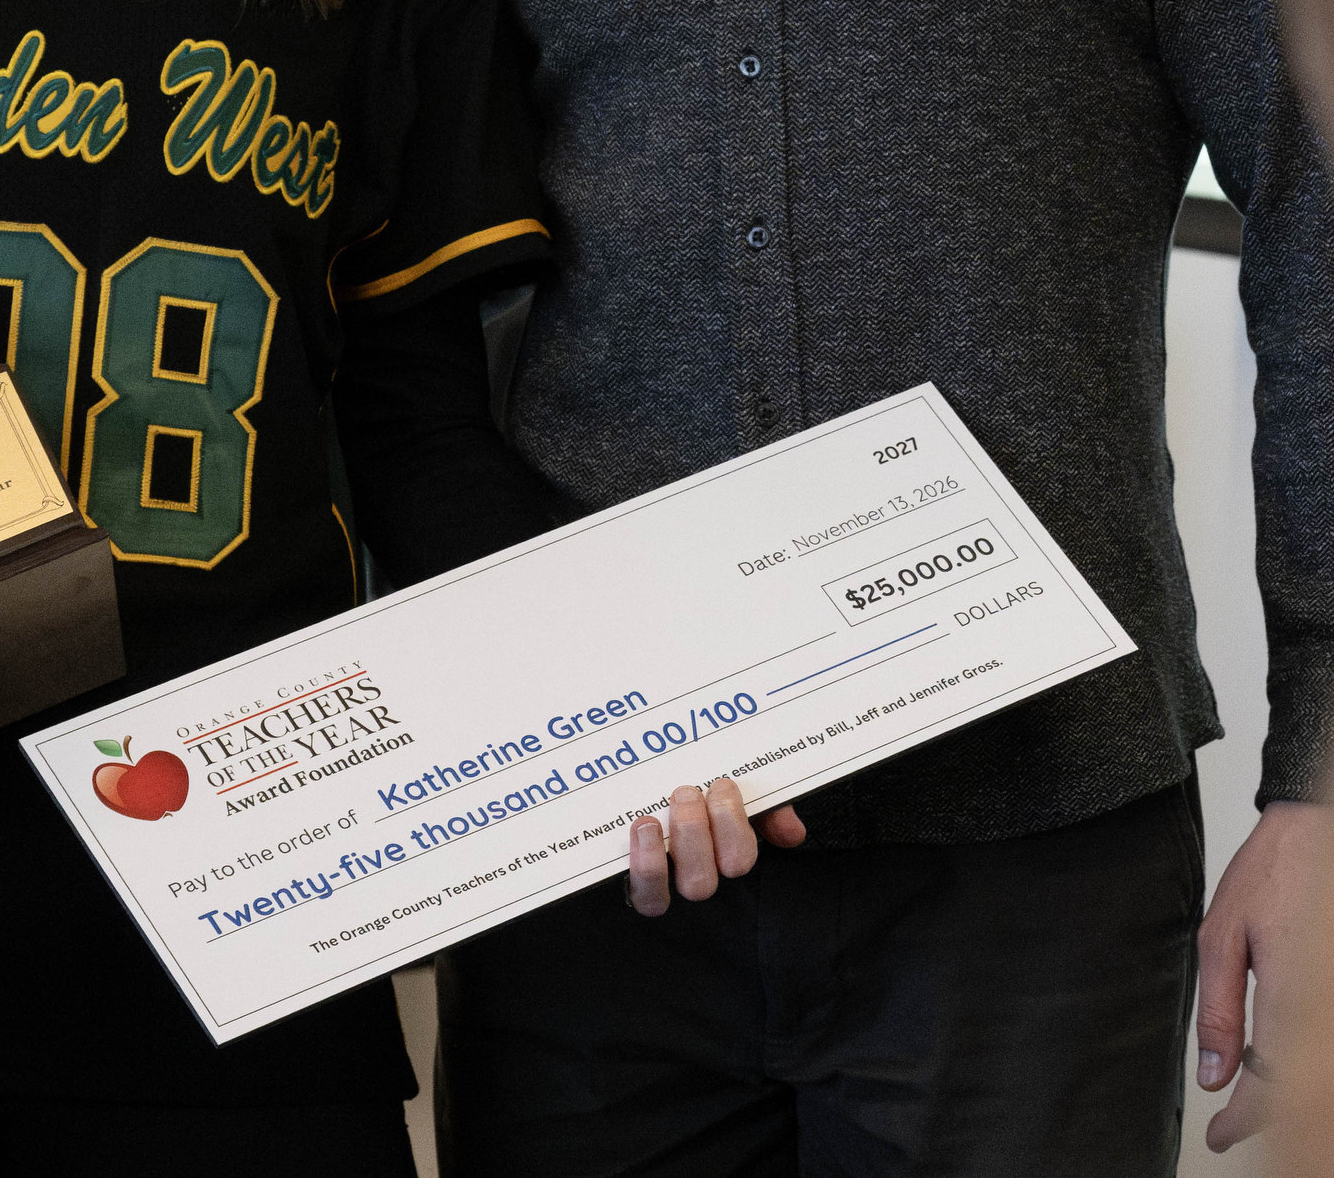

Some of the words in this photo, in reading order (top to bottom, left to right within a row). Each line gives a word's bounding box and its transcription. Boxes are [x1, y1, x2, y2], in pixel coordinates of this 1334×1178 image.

[160, 39, 341, 219] West
[872, 436, 918, 465] 2027
[737, 547, 791, 577] Date:
[791, 507, 886, 552] November
[887, 495, 915, 512] 13,
[913, 475, 959, 503] 2026
[844, 537, 995, 610] $25,000.00
[953, 581, 1044, 627] DOLLARS
[176, 699, 265, 739] ORANGE
[276, 660, 363, 699] COUNTY
[186, 676, 382, 768] TEACHERS
[207, 764, 236, 788] OF
[239, 743, 294, 774] THE
[291, 705, 401, 759] YEAR
[225, 774, 294, 817] Award
[291, 732, 415, 787] Foundation
[167, 874, 209, 900] Pay
[211, 862, 236, 881] to
[237, 846, 275, 871] the
[277, 823, 332, 855] order
[337, 809, 361, 830] of
[376, 733, 543, 811] Katherine
[547, 690, 648, 740] Green
[197, 842, 407, 937] Twenty-five
[410, 768, 570, 850] thousand
[574, 739, 640, 783] and
[642, 692, 758, 753] 00/100
[309, 935, 339, 955] The
[339, 914, 391, 941] Orange
[391, 895, 443, 920] County
[442, 865, 507, 899] Teachers
[507, 857, 523, 873] of
[523, 848, 549, 865] the
[547, 835, 582, 855] Year
[582, 813, 626, 842] Award
[731, 738, 807, 779] established
[806, 730, 825, 748] by
[825, 720, 855, 738] Bill,
[854, 706, 881, 726] Jeff
[881, 696, 907, 715] and
[909, 673, 961, 704] Jennifer
[962, 660, 1005, 680] Gross.
